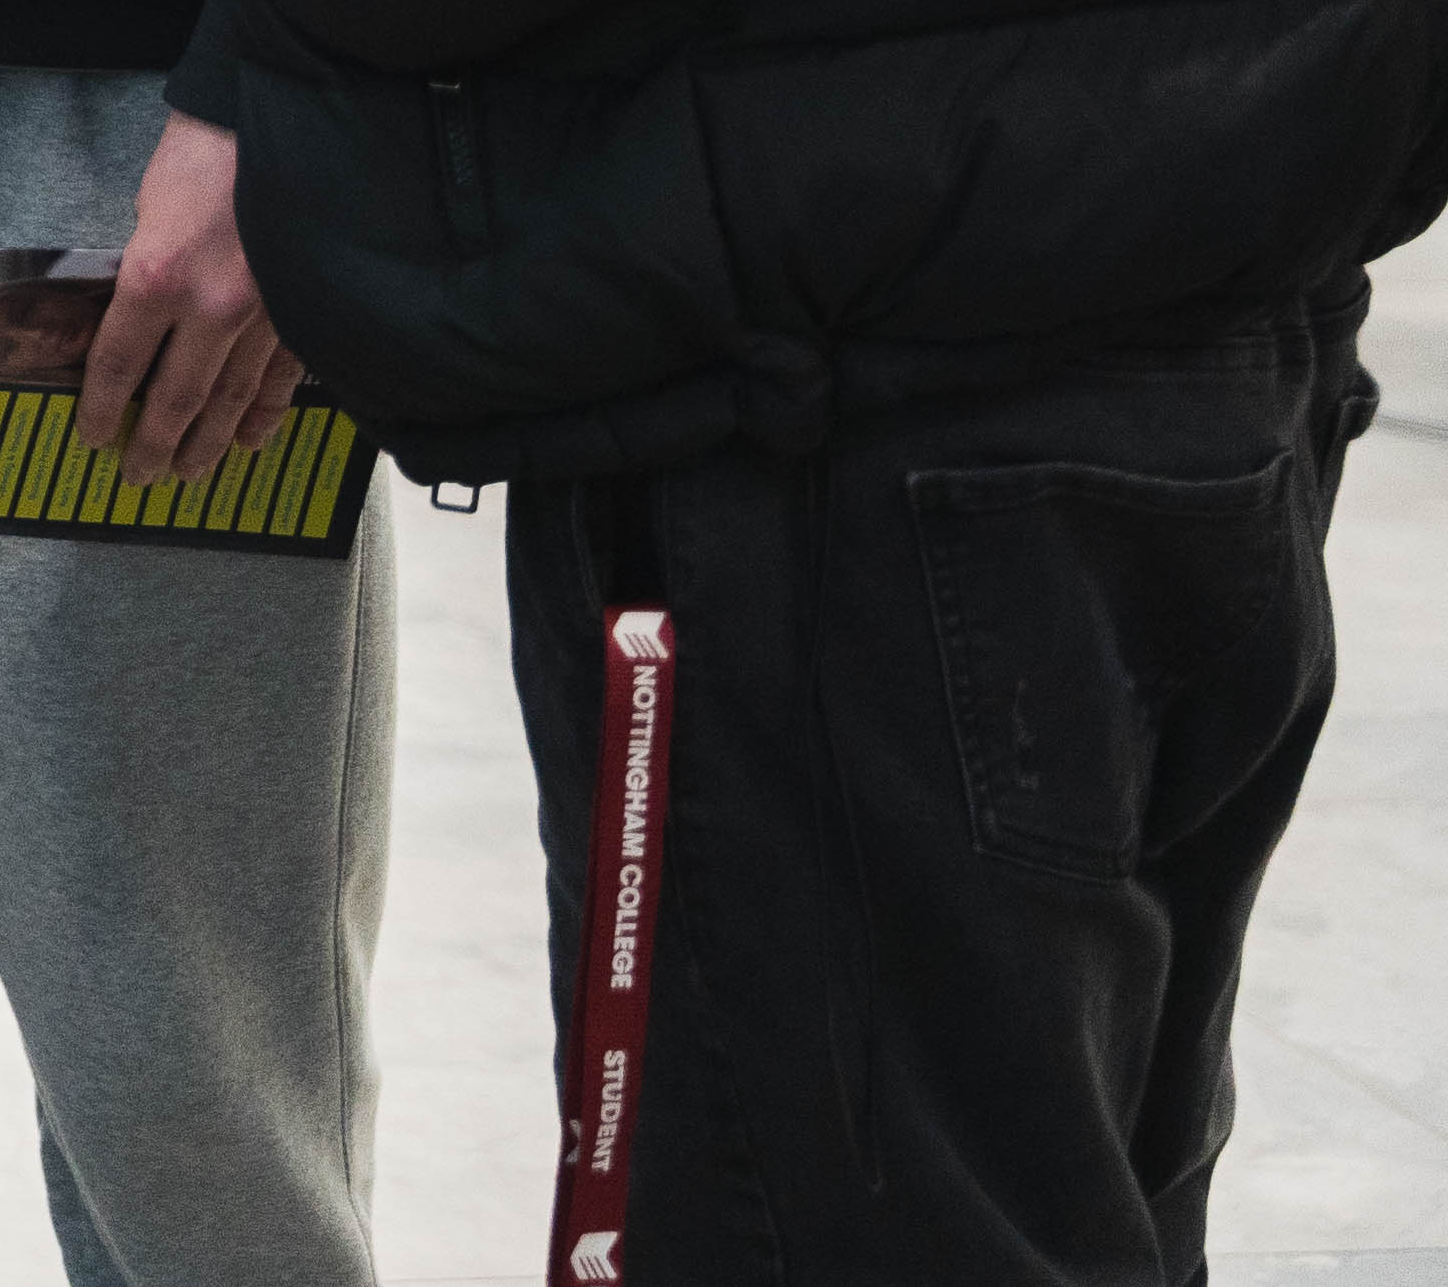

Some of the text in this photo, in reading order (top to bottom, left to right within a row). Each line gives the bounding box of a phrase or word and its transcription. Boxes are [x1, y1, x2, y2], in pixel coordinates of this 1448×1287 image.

[610, 665, 656, 990] NOTTINGHAM COLLEGE
[592, 1049, 627, 1172] STUDENT
